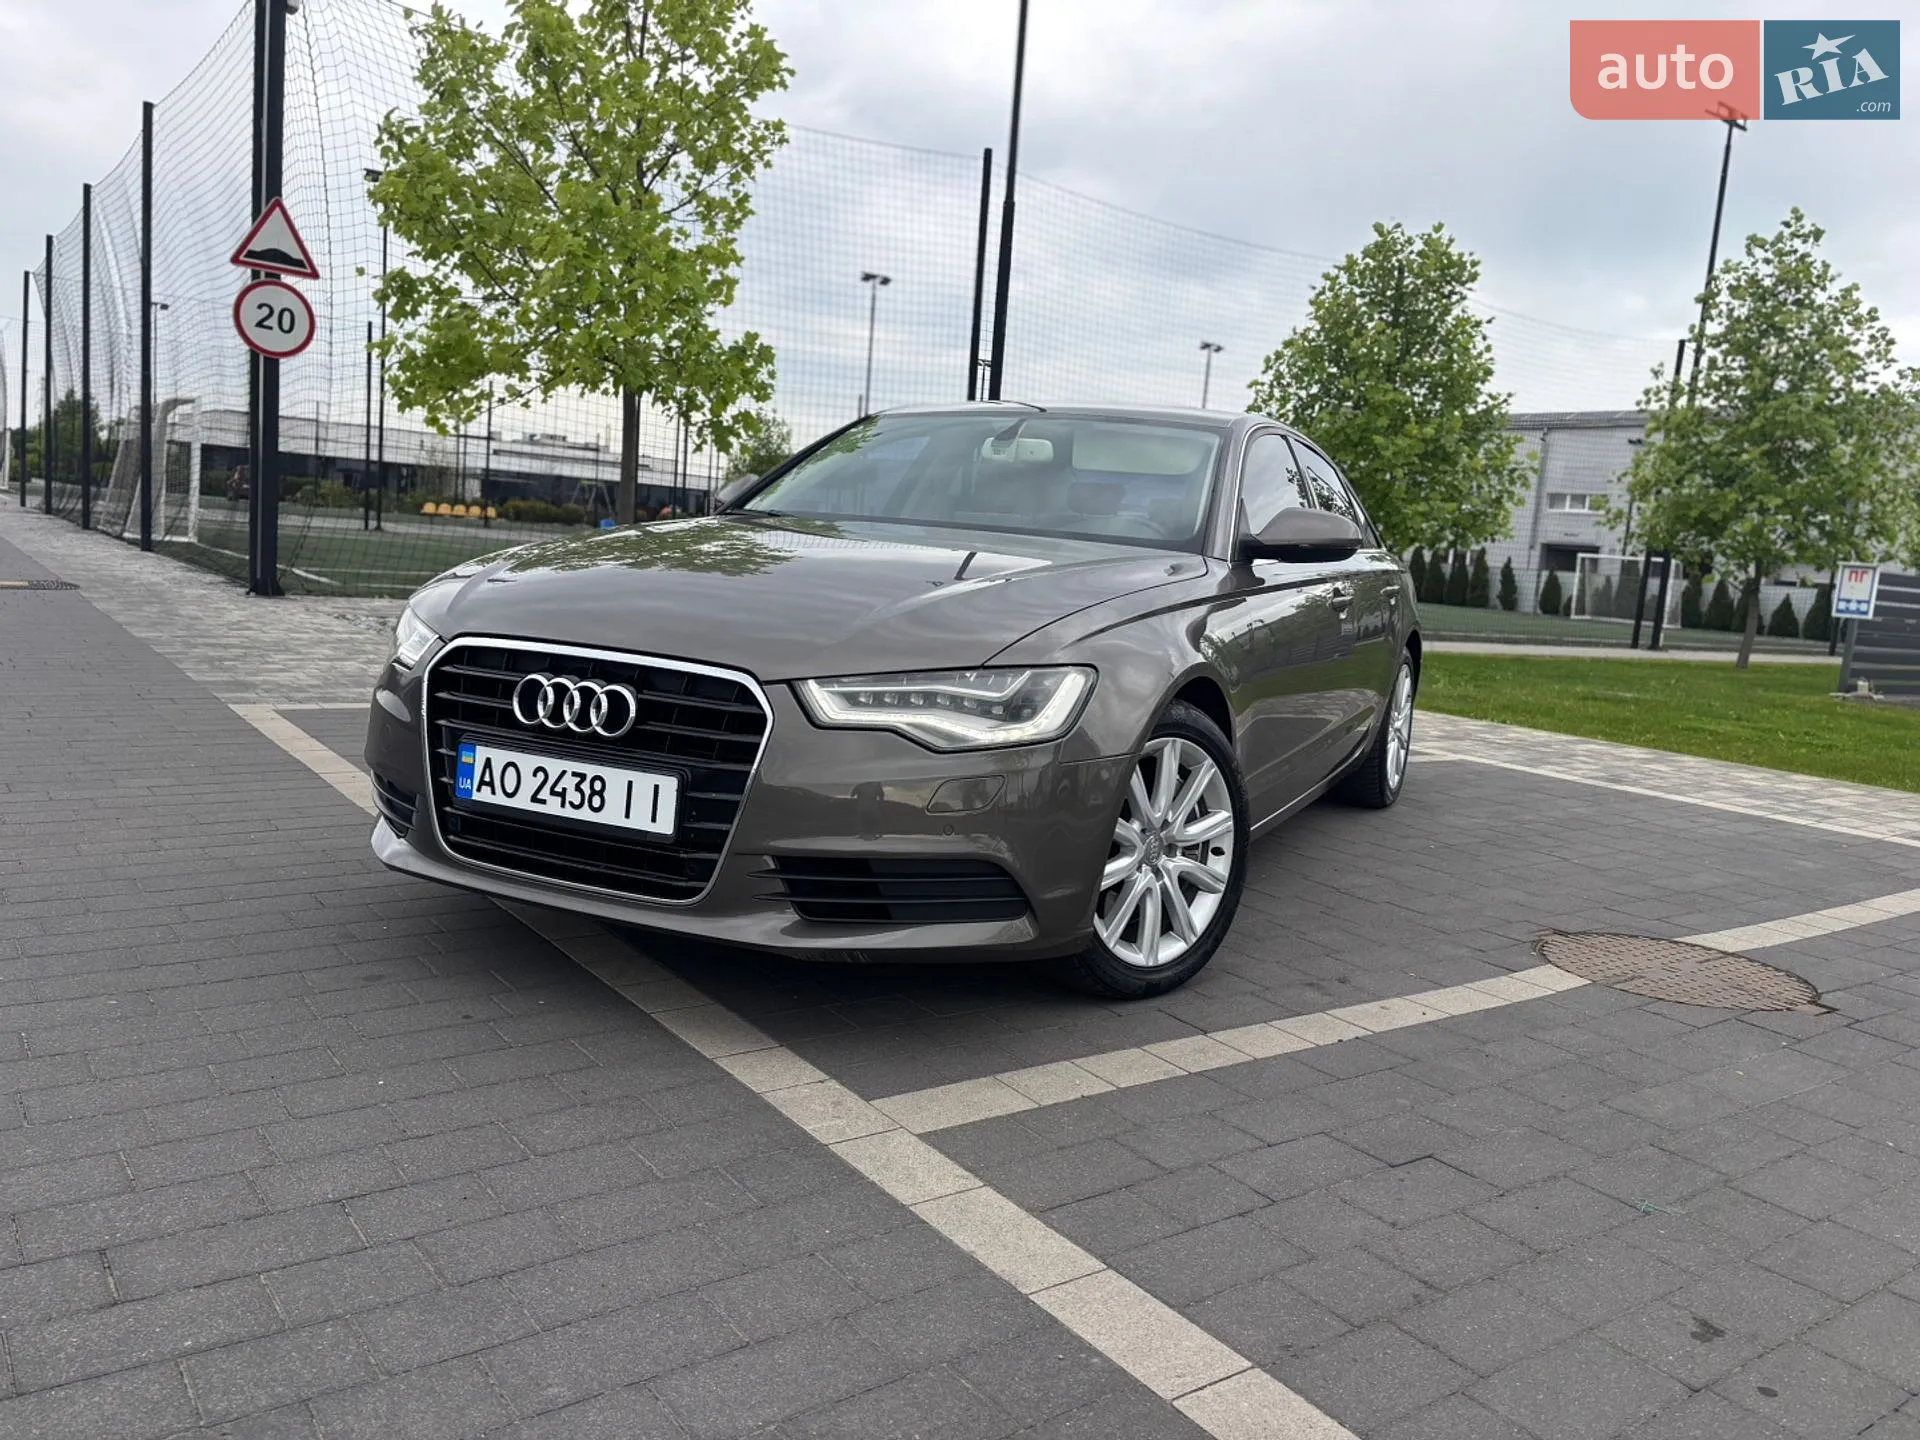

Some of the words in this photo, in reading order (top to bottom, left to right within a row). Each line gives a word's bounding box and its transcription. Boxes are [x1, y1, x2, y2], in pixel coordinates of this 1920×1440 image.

[254, 303, 295, 334] 20
[458, 776, 472, 790] UA
[476, 757, 521, 798] AO
[530, 766, 606, 813] 2438
[625, 780, 659, 823] II
